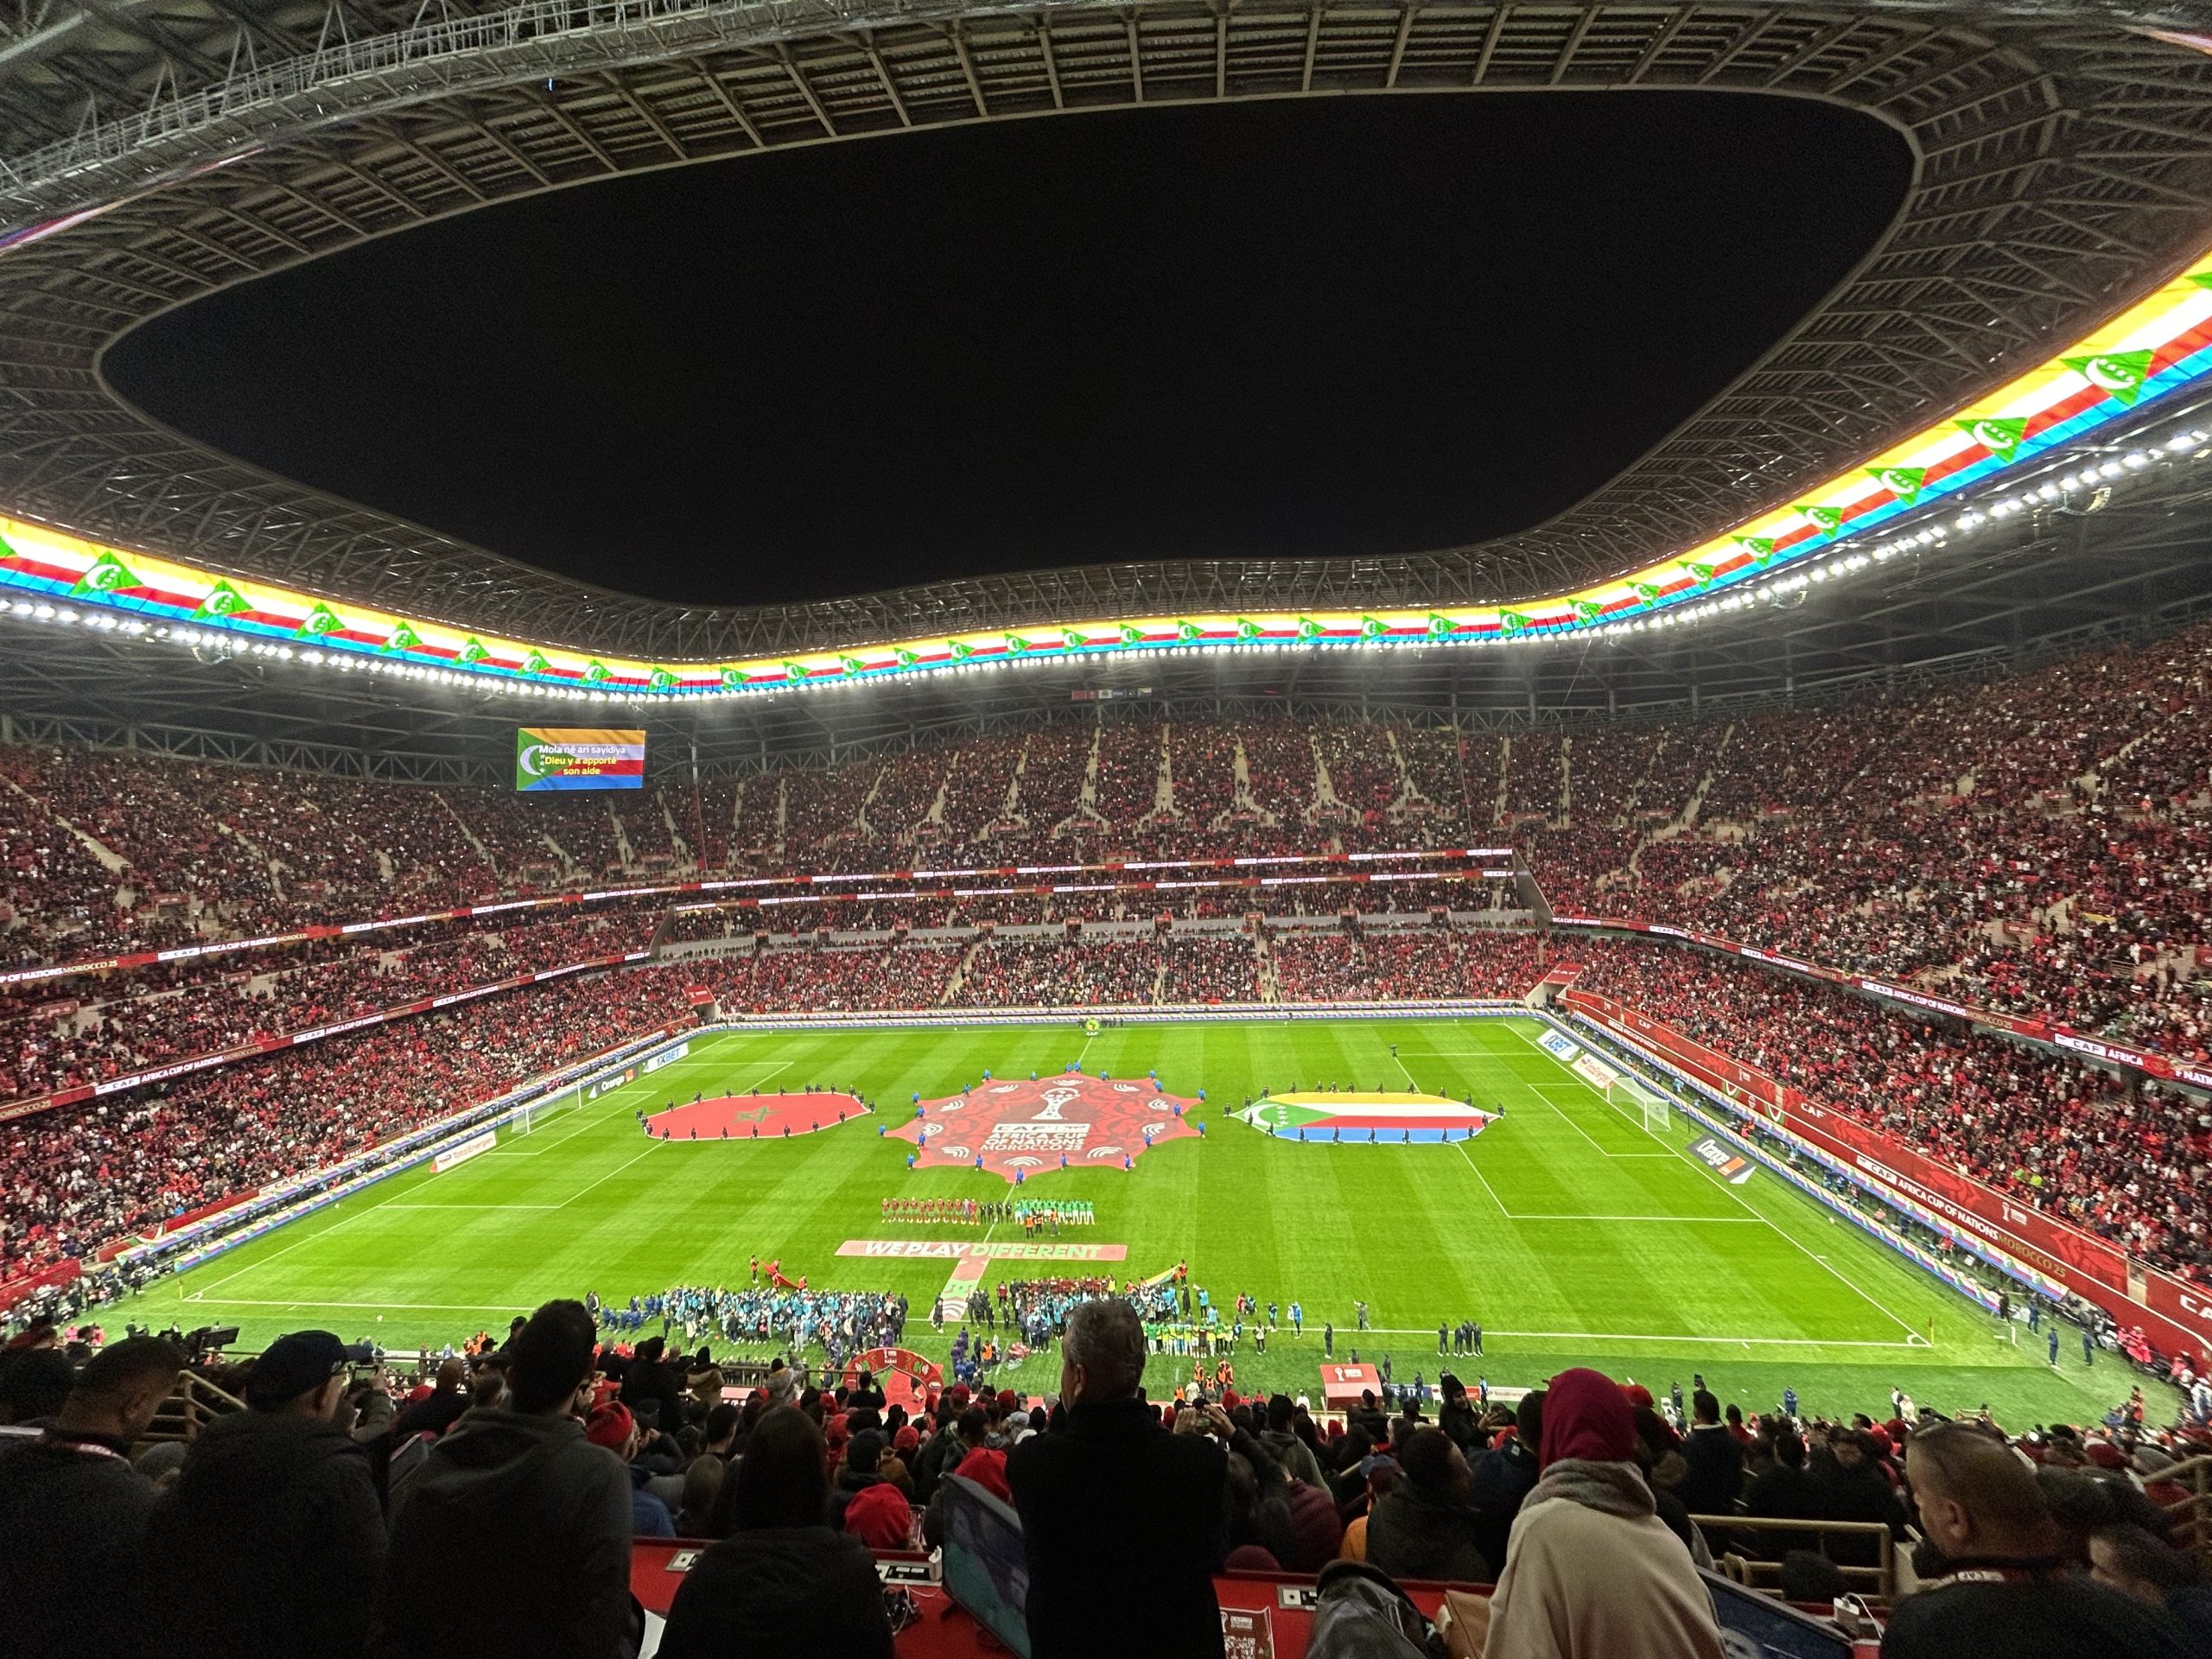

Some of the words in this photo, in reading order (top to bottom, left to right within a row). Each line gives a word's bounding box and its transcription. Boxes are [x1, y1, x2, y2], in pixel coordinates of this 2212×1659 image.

[538, 745, 562, 753] Mola
[564, 745, 575, 753] né
[591, 746, 626, 756] sayidiya
[568, 758, 574, 766] y
[582, 756, 617, 766] apporté
[582, 766, 601, 775] aide
[63, 962, 107, 974] MOROCCO
[1894, 990, 1916, 1002] AFRICA
[1916, 996, 1928, 1005] CUP
[1544, 1034, 1572, 1053] 1XBET
[657, 1048, 681, 1066] 1XBET
[2074, 1039, 2101, 1054] CAF
[2107, 1048, 2144, 1066] AFRICA
[2183, 1071, 2212, 1086] NATI
[112, 1079, 135, 1089] CAF
[141, 1071, 168, 1083] AFRICA
[168, 1066, 184, 1077] CUP
[184, 1063, 194, 1072] OF
[194, 1056, 224, 1070] NATIONS
[601, 1075, 625, 1091] Orange
[0, 1103, 40, 1120] OROCCO
[1800, 1103, 1827, 1119] CAF
[1696, 1139, 1731, 1166] Orange
[1871, 1164, 1893, 1181] CAF
[1897, 1179, 1927, 1202] AFRICA
[1928, 1194, 1945, 1210] CUP
[1945, 1203, 1959, 1217] OF
[1957, 1212, 1999, 1241] NATIONS
[1998, 1233, 2052, 1269] MOROCCO
[2051, 1265, 2067, 1279] 25
[864, 1242, 904, 1255] WE
[904, 1243, 970, 1256] PLAY
[969, 1243, 1103, 1258] DIFFERENT
[2179, 1294, 2212, 1319] CA
